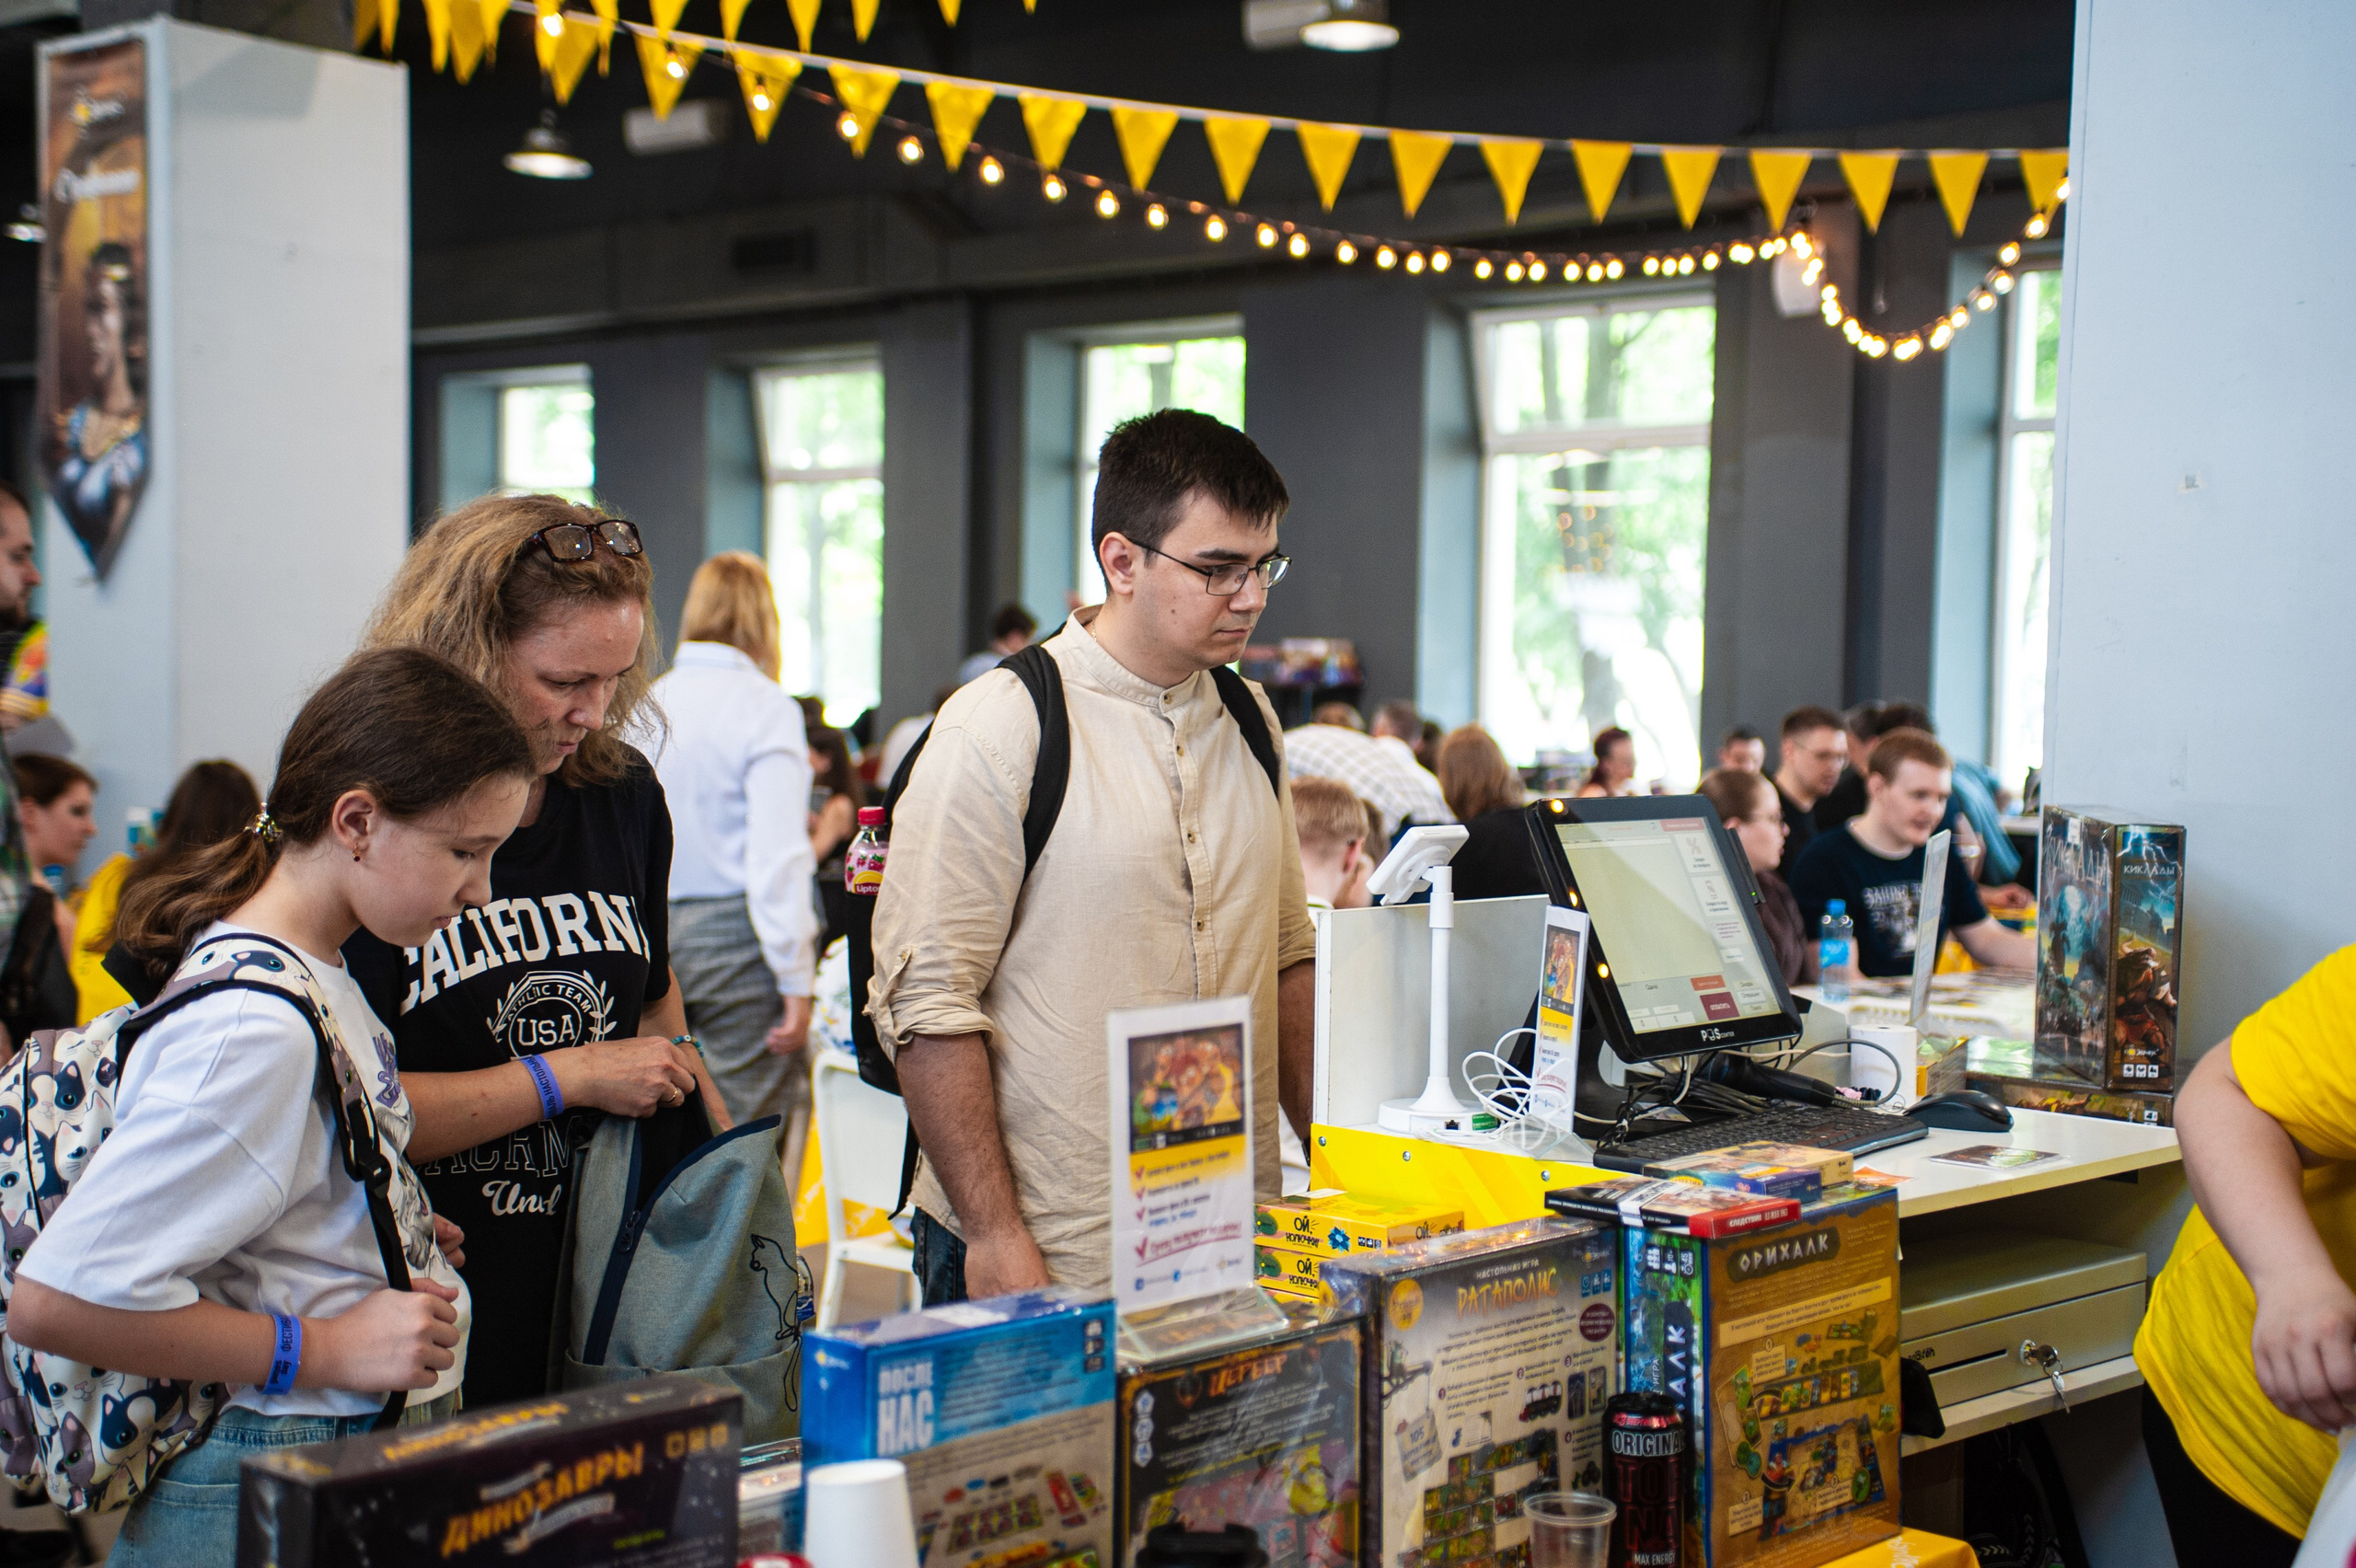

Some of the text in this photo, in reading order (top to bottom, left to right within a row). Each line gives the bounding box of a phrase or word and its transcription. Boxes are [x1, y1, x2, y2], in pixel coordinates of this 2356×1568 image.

[2123, 864, 2175, 875] КИКЛАДЫ
[856, 885, 880, 894] Lipto
[400, 891, 650, 1016] CALIFORN
[557, 984, 592, 1012] TEAM
[516, 1014, 575, 1046] USA
[1475, 1258, 1540, 1279] НАСТОЛЬНАЯ ИГРА
[1738, 1233, 1829, 1273] ОРИХАЛК
[1457, 1266, 1559, 1321] РАТАПОЛИС
[877, 1388, 934, 1457] НАС
[441, 1442, 644, 1557] ДИНОЗАВРЫ
[1634, 1550, 1675, 1565] MAX ENERGY
